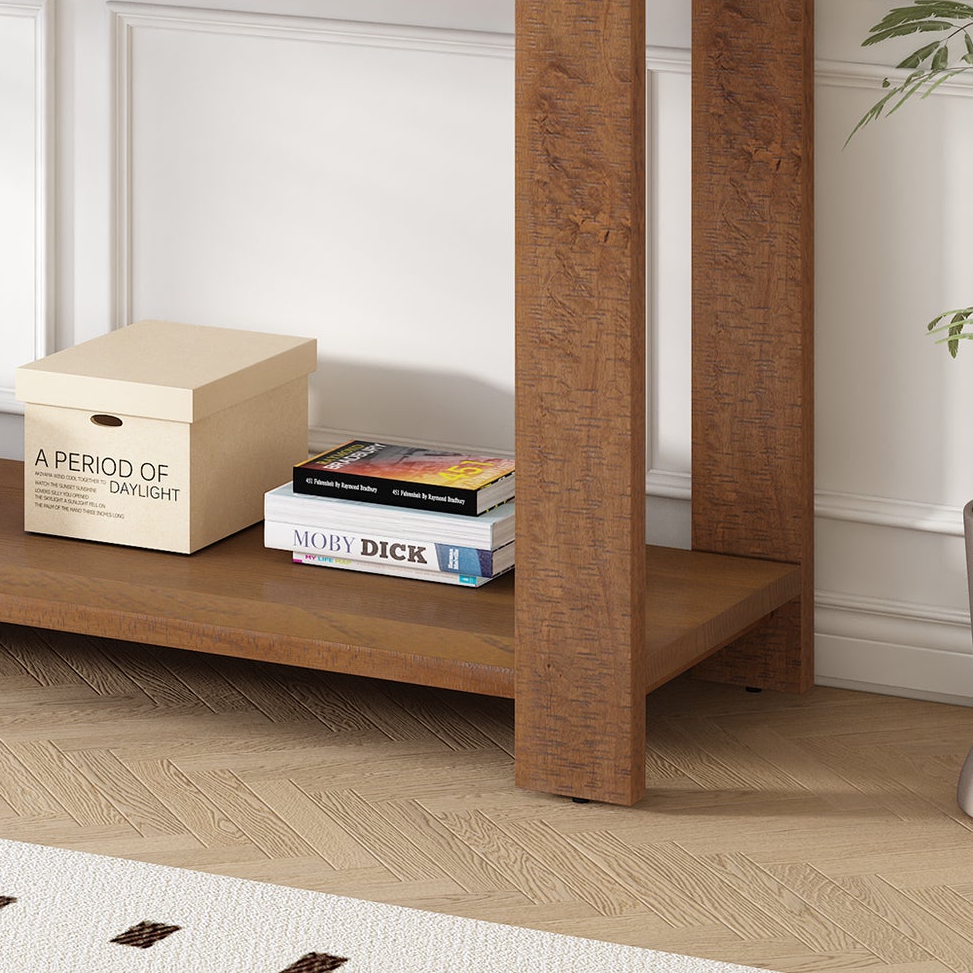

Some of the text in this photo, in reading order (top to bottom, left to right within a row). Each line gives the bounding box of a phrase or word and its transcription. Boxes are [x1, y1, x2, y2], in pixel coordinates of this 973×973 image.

[34, 449, 169, 483] A PERIOD OF
[438, 460, 495, 481] 451
[109, 480, 181, 502] DAYLIGHT
[292, 529, 428, 564] MOBY DICK
